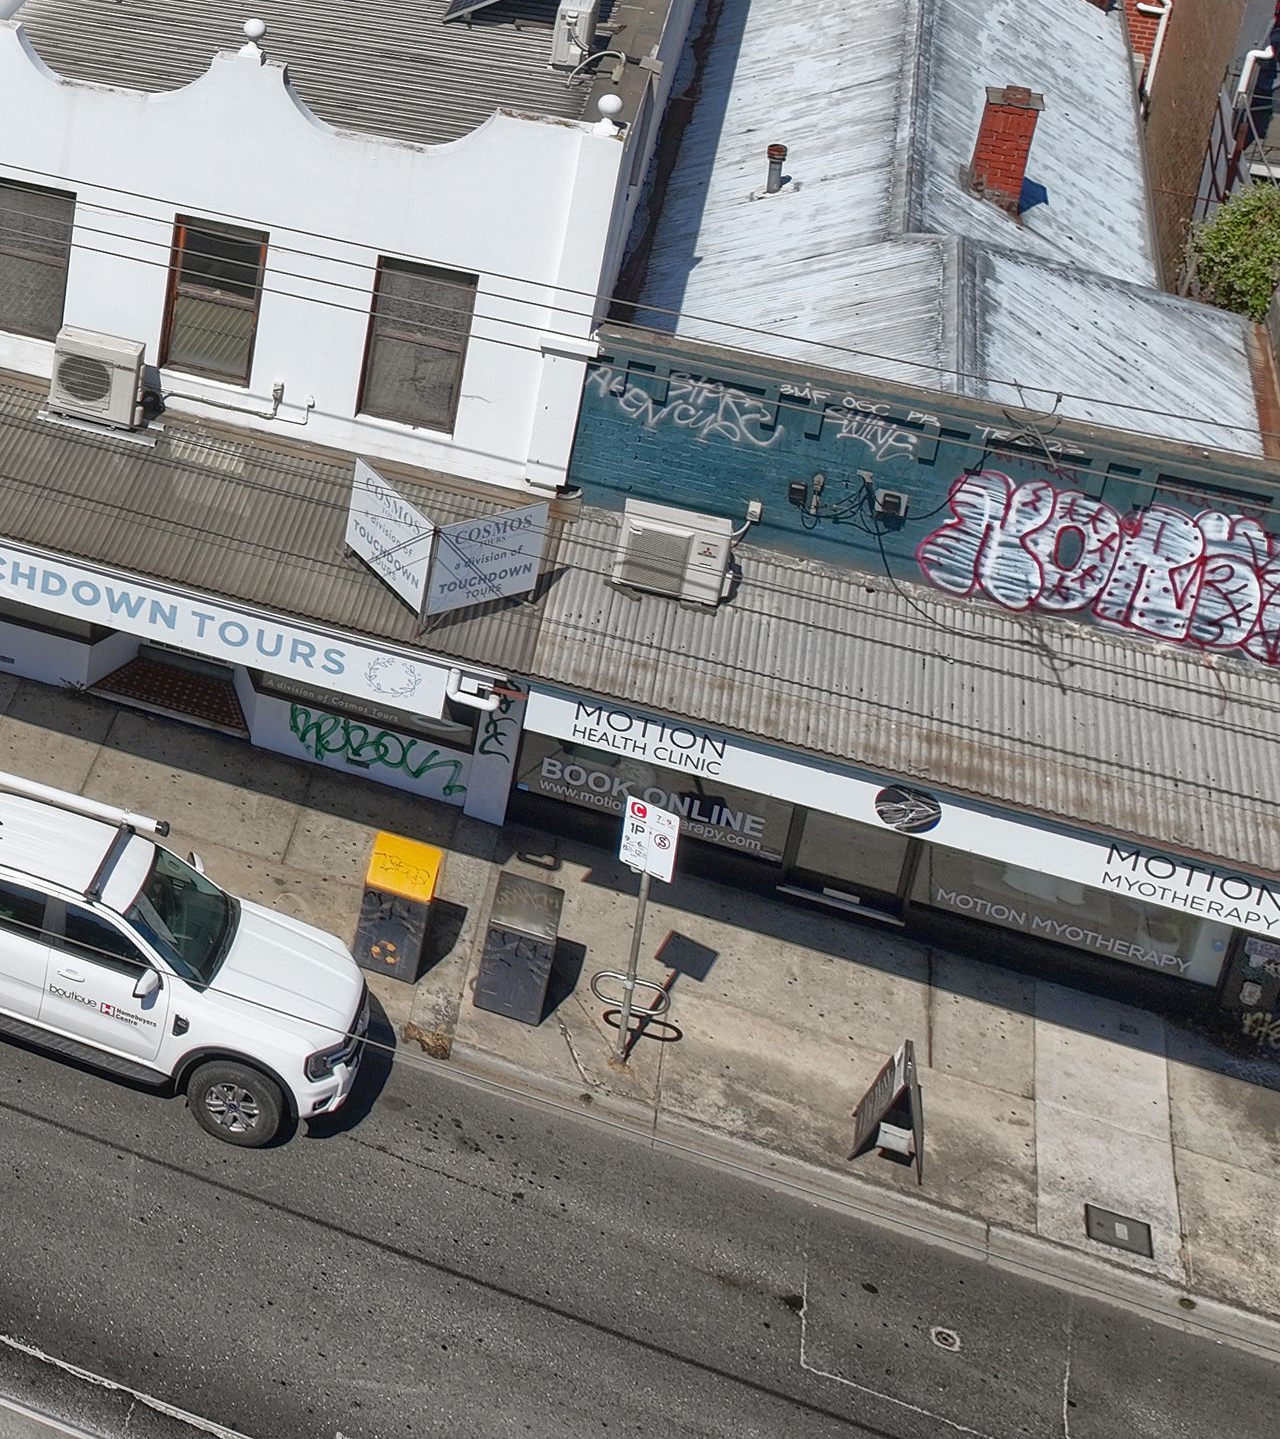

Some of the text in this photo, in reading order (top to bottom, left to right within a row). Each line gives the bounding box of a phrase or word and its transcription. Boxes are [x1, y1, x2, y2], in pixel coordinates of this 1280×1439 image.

[365, 477, 421, 535] COSMOS
[370, 515, 403, 547] division
[403, 546, 414, 558] of
[454, 514, 534, 546] COSMOS
[353, 519, 420, 589] TOUCHDOWN
[371, 551, 397, 582] TOURS
[464, 551, 508, 568] division
[510, 545, 524, 557] of
[438, 563, 533, 595] TOUCHDOWN
[465, 584, 502, 600] TOURS
[191, 610, 347, 675] TOURS
[266, 679, 399, 723] A division of Cosmos Tours
[572, 723, 722, 776] HEALTH CLINIC
[574, 700, 728, 760] MOTION
[540, 757, 767, 839] BOOK ONLINE
[630, 822, 645, 835] 1P
[1106, 843, 1280, 914] MOTION
[1101, 871, 1280, 932] MYOTHERAPY
[936, 888, 1191, 972] MOTION MYOTHERAPY
[49, 983, 97, 1008] boutique
[116, 1007, 157, 1028] Homebuyers
[115, 1013, 138, 1026] Centre
